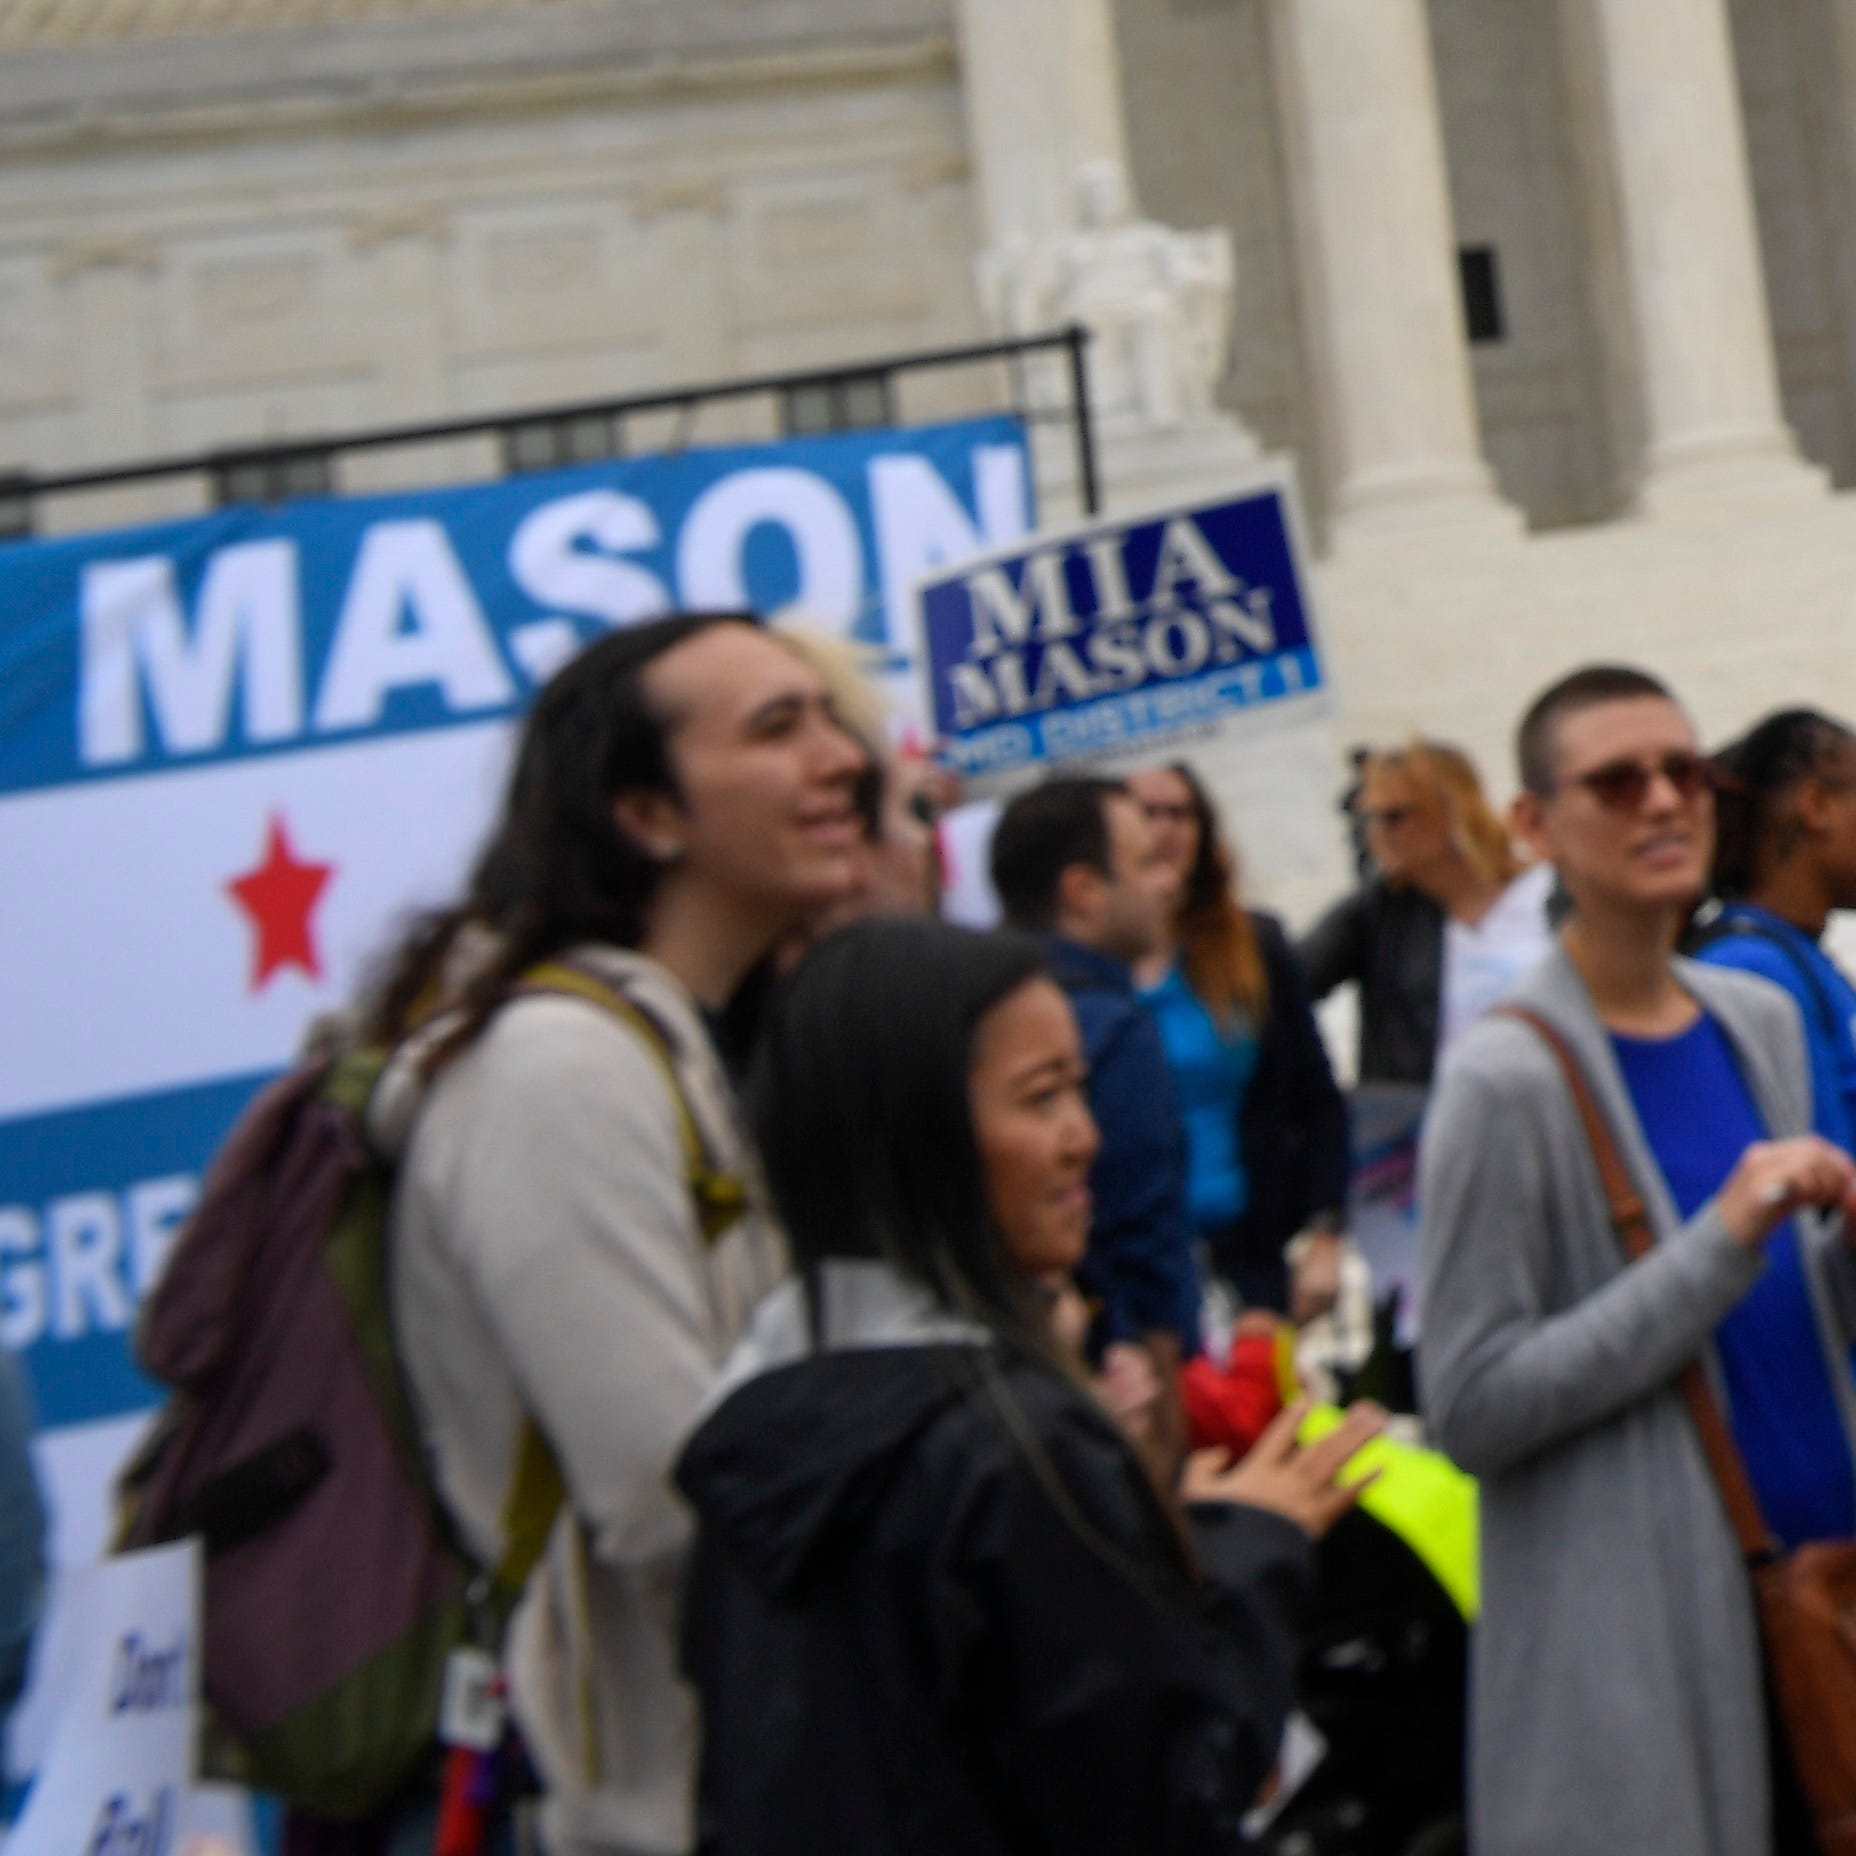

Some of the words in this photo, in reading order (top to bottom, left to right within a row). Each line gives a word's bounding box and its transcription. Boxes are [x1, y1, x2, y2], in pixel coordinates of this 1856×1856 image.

[78, 444, 1027, 768] MASON
[967, 516, 1244, 656] MIA
[948, 588, 1277, 725] MASON
